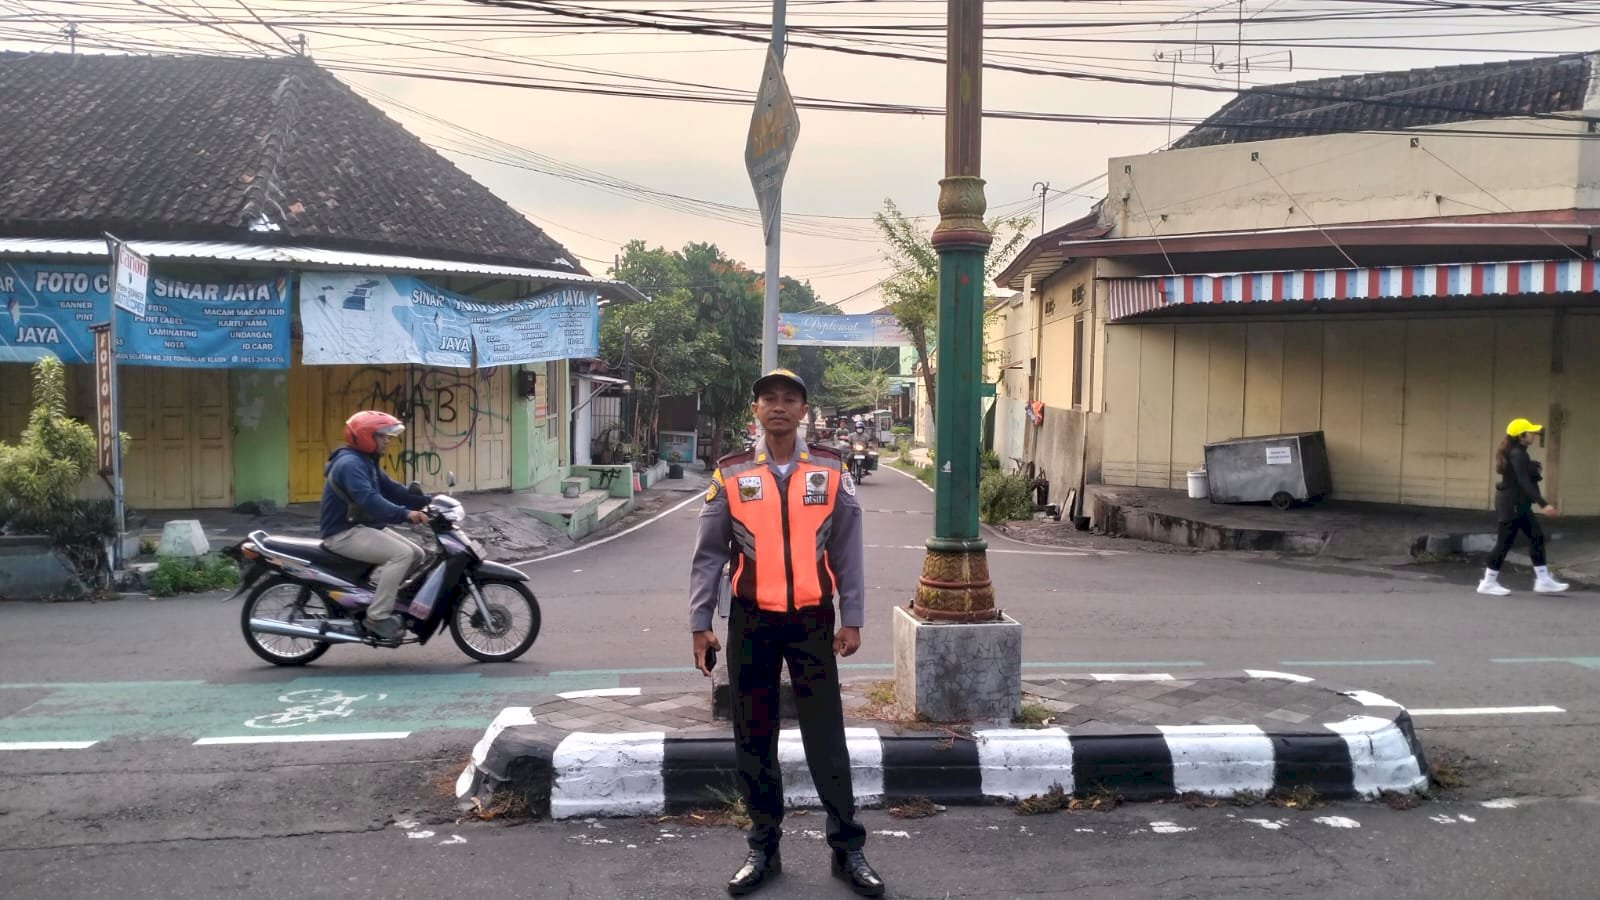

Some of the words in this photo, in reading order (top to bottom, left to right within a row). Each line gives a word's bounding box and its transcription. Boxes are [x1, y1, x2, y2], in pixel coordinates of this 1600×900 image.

[35, 271, 89, 294] FOTO
[153, 278, 219, 301] SINAR
[223, 283, 271, 301] JAYA
[412, 289, 445, 308] SINAR
[561, 288, 587, 306] JAYA
[59, 301, 93, 309] BANNER
[147, 304, 168, 312] FOTO
[203, 308, 235, 316] MACAM
[236, 308, 266, 316] MACAM
[76, 313, 93, 321] PINT
[160, 316, 185, 325] LABEL
[16, 327, 60, 343] JAYA
[148, 328, 198, 338] LAMINATING
[230, 331, 273, 339] UNDANGAN
[164, 341, 185, 349] NOTA
[242, 343, 250, 351] ID
[252, 343, 273, 351] CARD
[440, 335, 471, 352] JAYA
[99, 333, 109, 396] FOTO
[101, 403, 111, 467] KOPI
